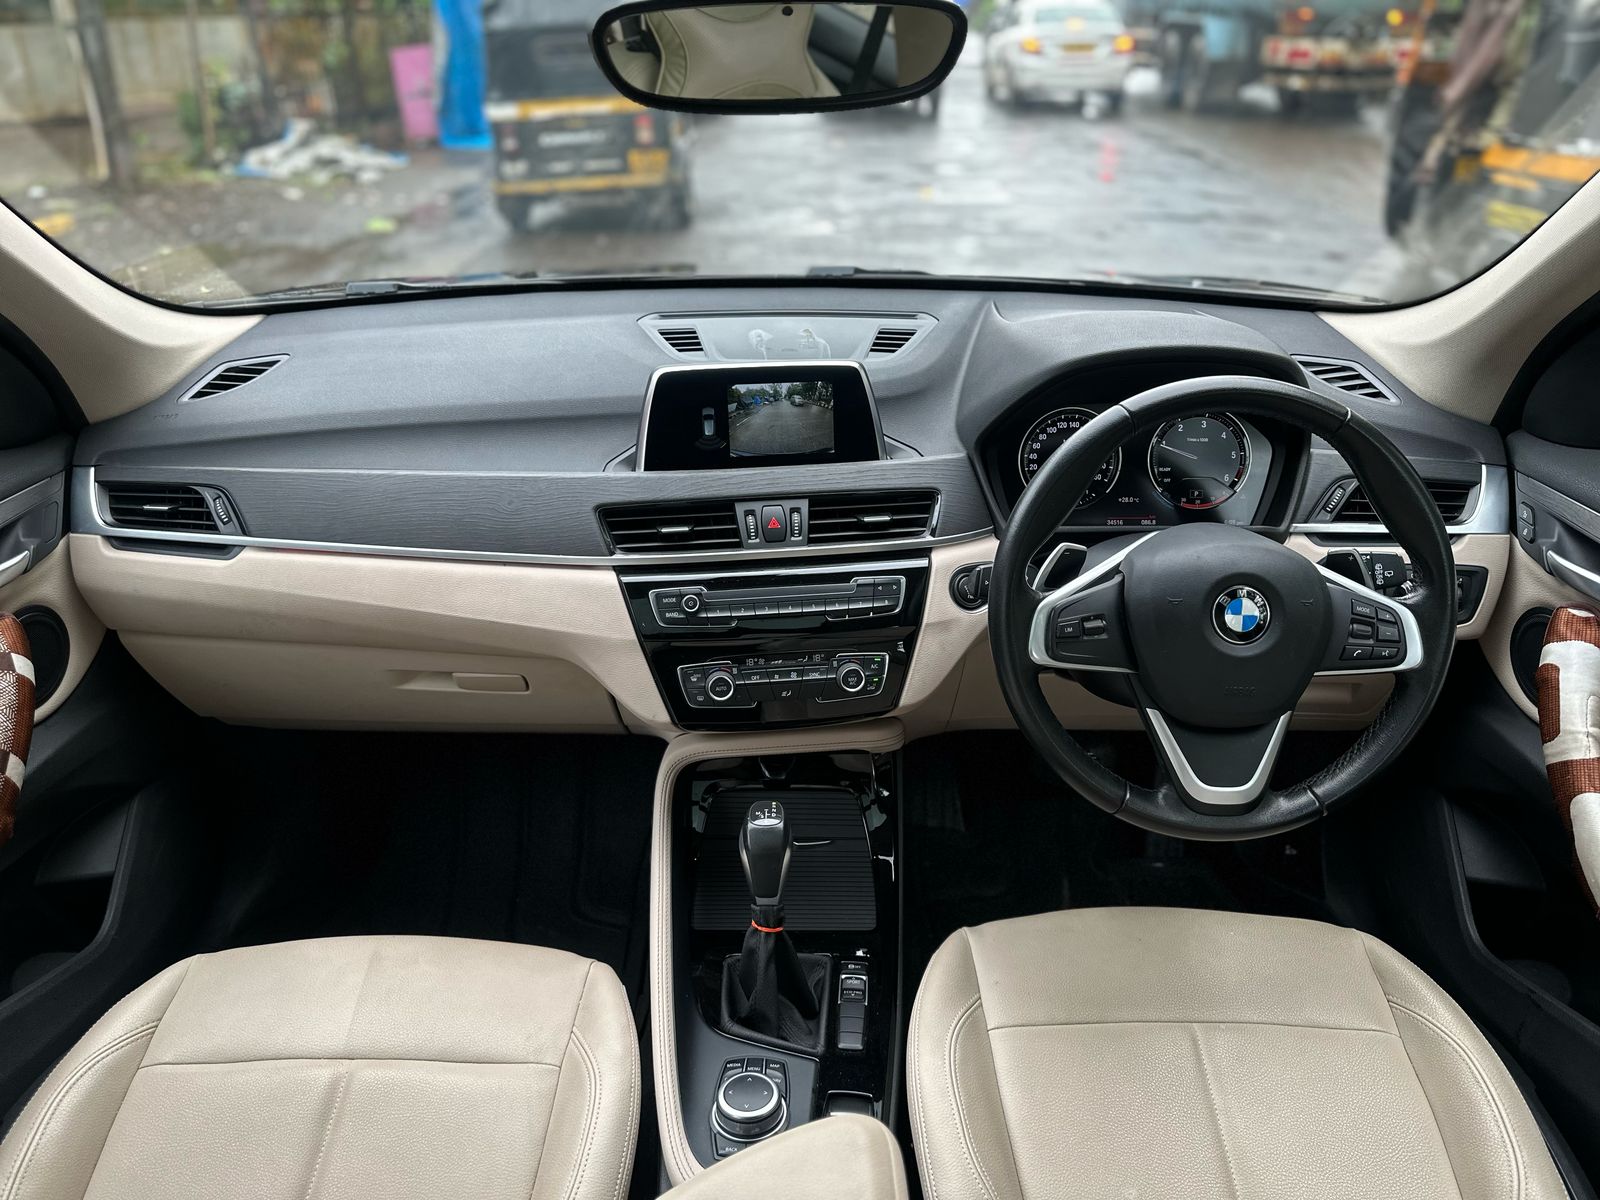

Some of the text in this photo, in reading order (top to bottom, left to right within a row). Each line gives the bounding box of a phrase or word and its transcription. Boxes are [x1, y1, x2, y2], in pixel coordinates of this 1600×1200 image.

[1178, 424, 1184, 432] 2
[1202, 420, 1206, 428] 3
[1220, 432, 1226, 440] 4
[1232, 450, 1236, 458] 5
[1224, 474, 1230, 482] 6
[1219, 589, 1265, 607] BMW
[1356, 606, 1370, 614] MODE
